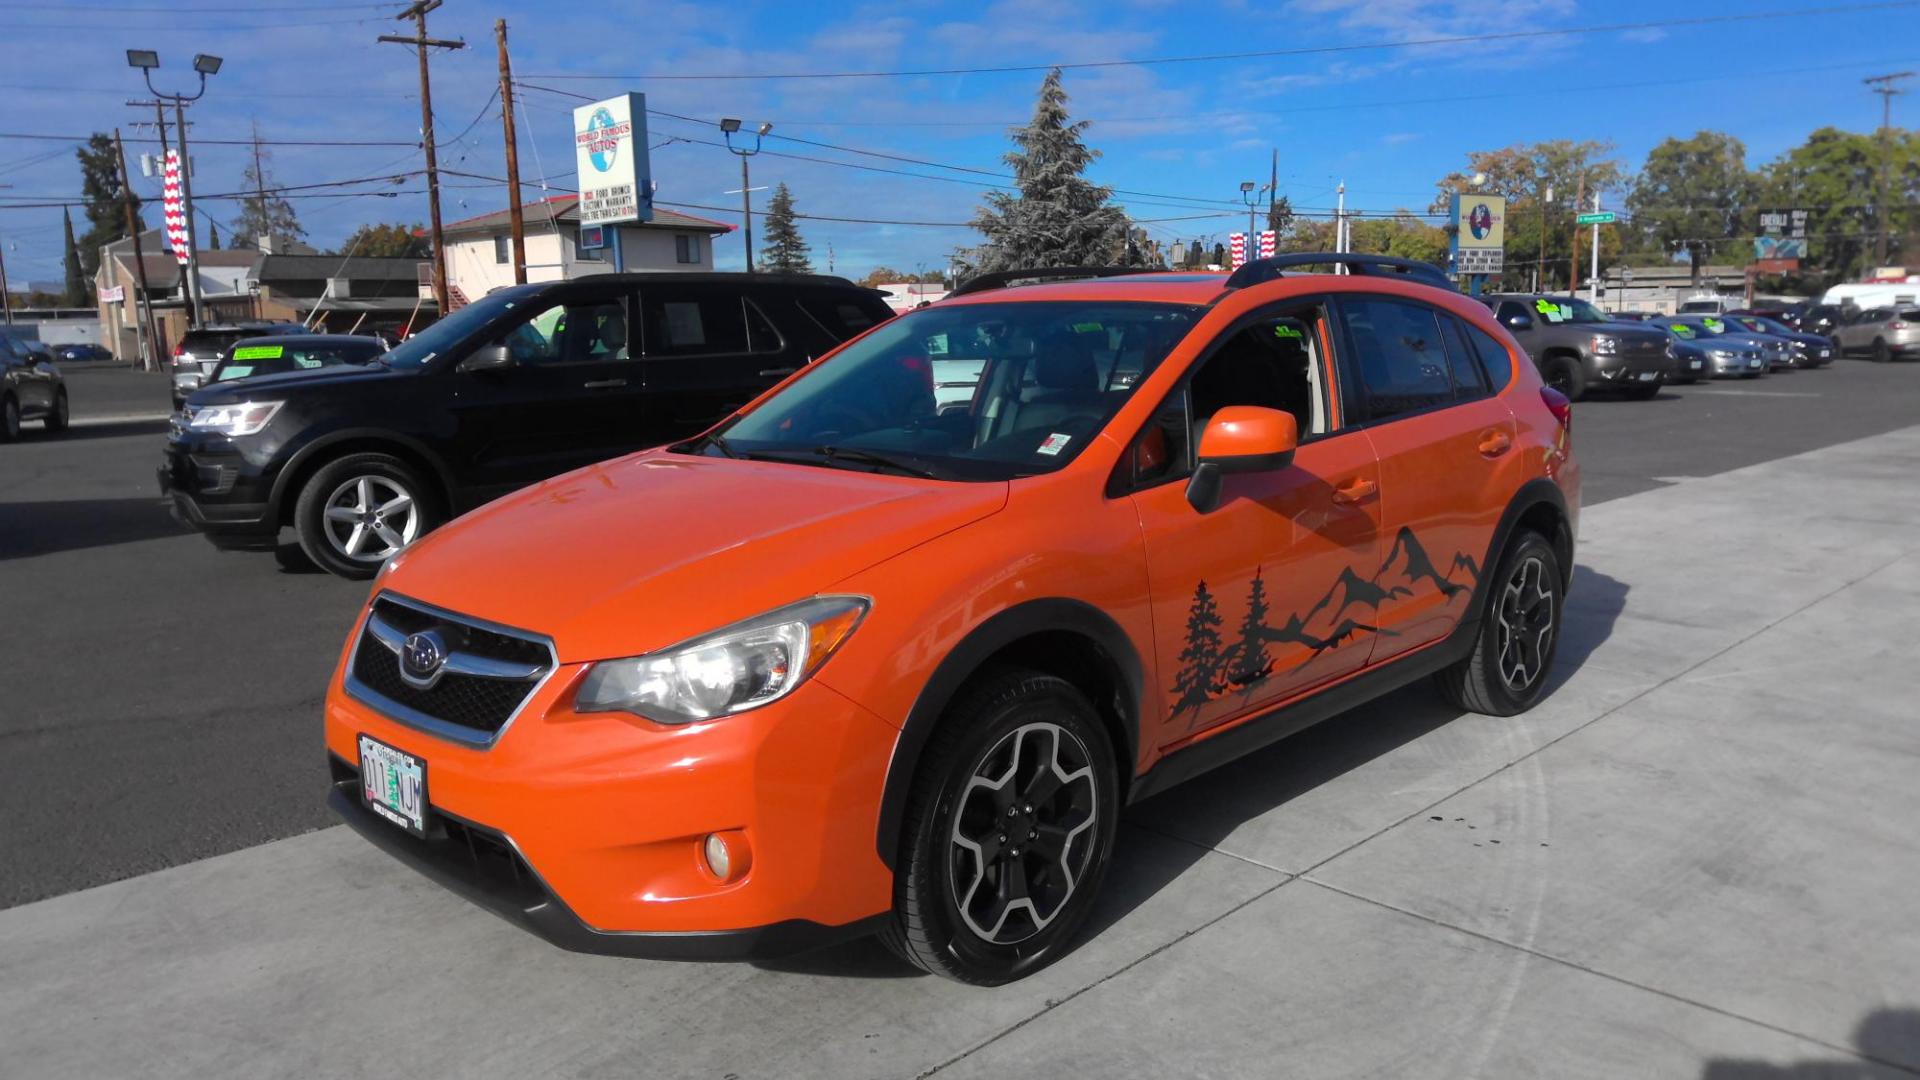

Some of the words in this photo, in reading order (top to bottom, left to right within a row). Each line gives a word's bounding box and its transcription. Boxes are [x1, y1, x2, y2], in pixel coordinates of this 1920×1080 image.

[577, 131, 599, 143] WORLD
[601, 124, 630, 137] FAMOUS
[596, 188, 608, 199] FORD
[611, 185, 631, 197] BRONCO
[583, 200, 603, 211] FACTORY
[606, 196, 632, 207] WARRANTY
[612, 207, 621, 216] SAT
[363, 754, 386, 798] 011
[395, 769, 421, 815] NJM
